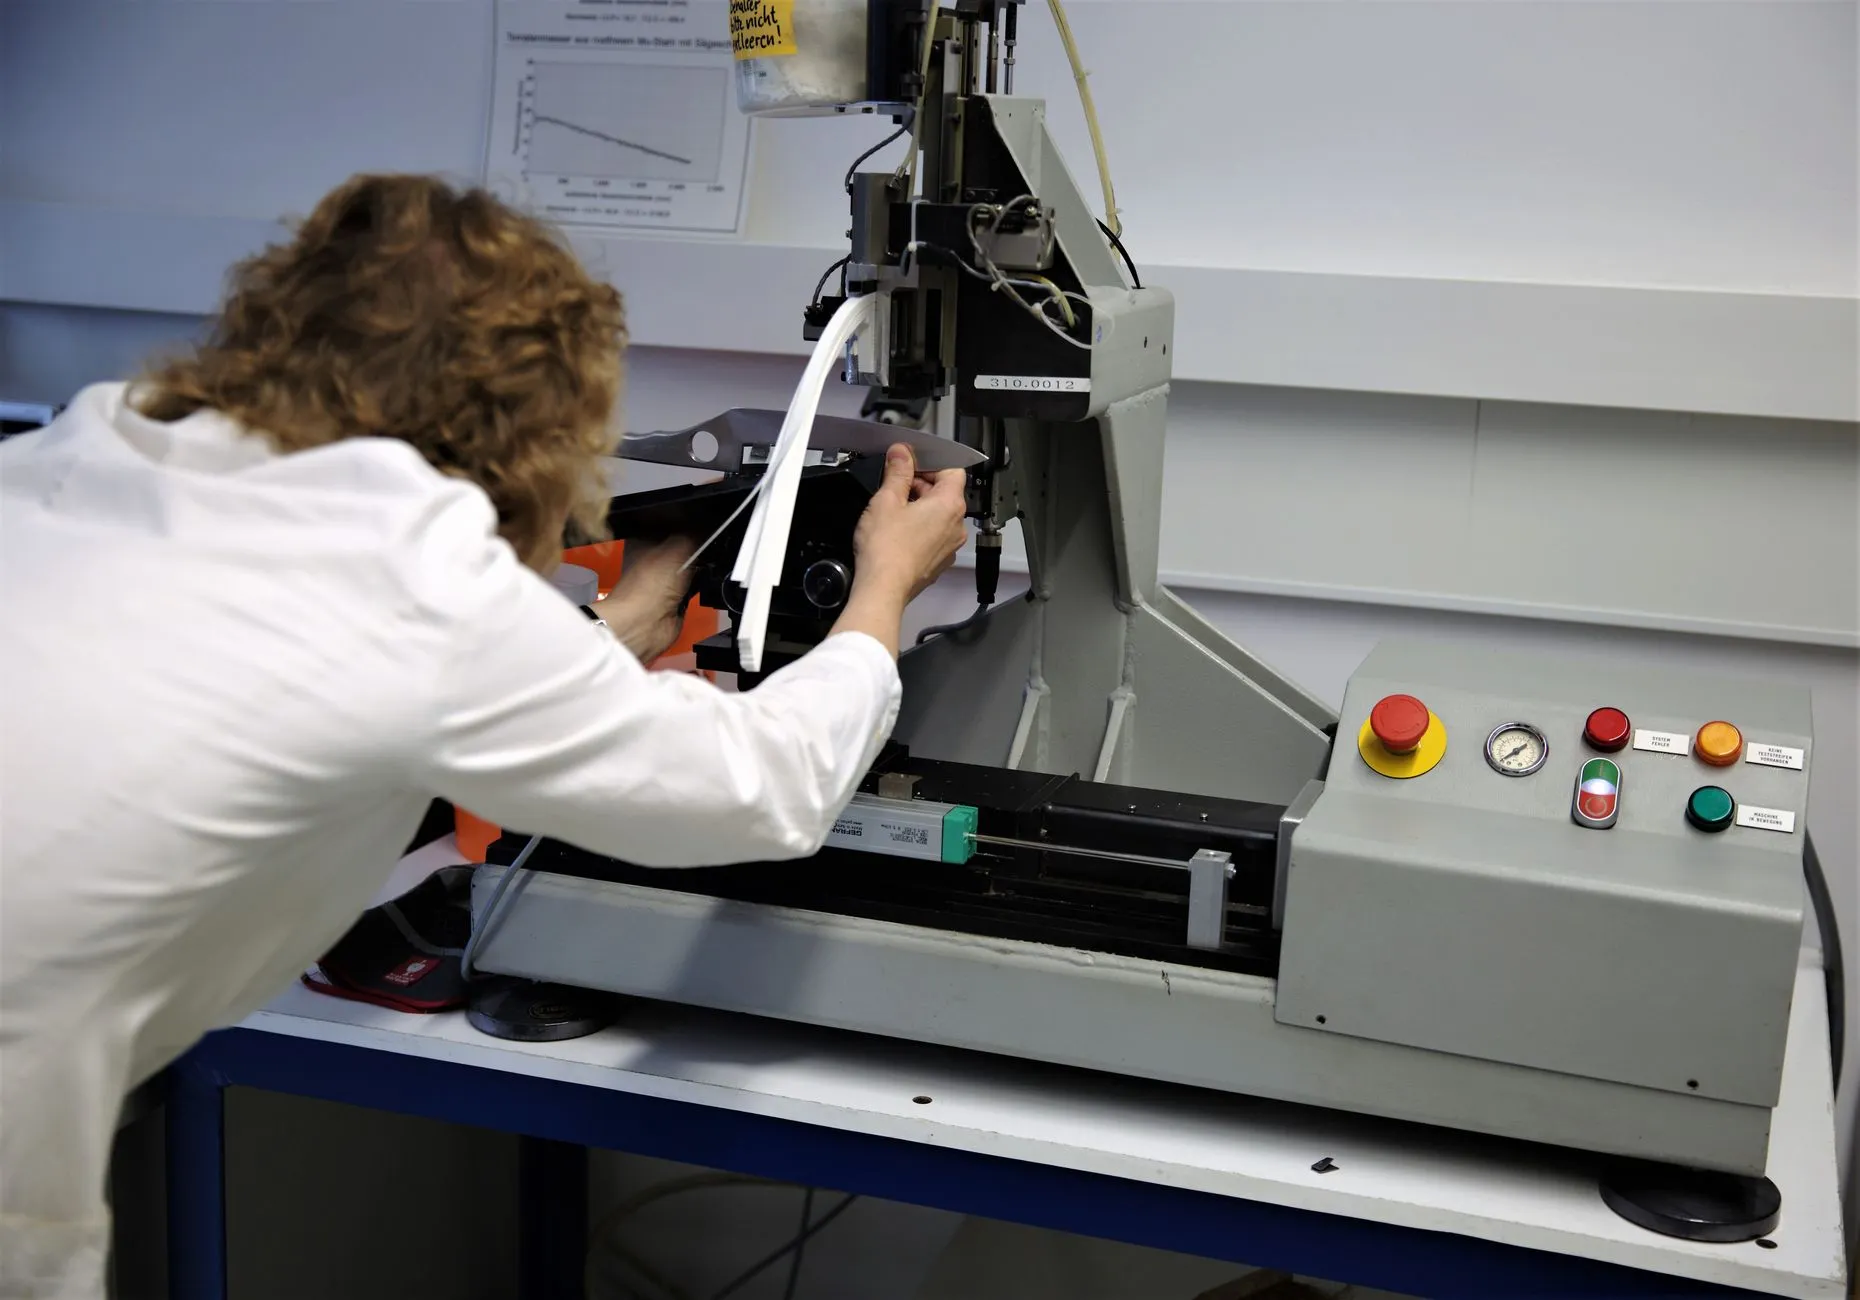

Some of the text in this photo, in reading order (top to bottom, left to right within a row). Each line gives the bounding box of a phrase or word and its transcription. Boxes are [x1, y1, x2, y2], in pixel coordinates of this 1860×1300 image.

[745, 4, 778, 29] nicht
[990, 377, 1075, 390] 310.0012
[1758, 751, 1792, 760] TESTSTREIFEN
[1760, 756, 1789, 764] VORHANDEN
[1753, 812, 1778, 820] MASCHINE
[1756, 817, 1783, 826] BEWEGUNG
